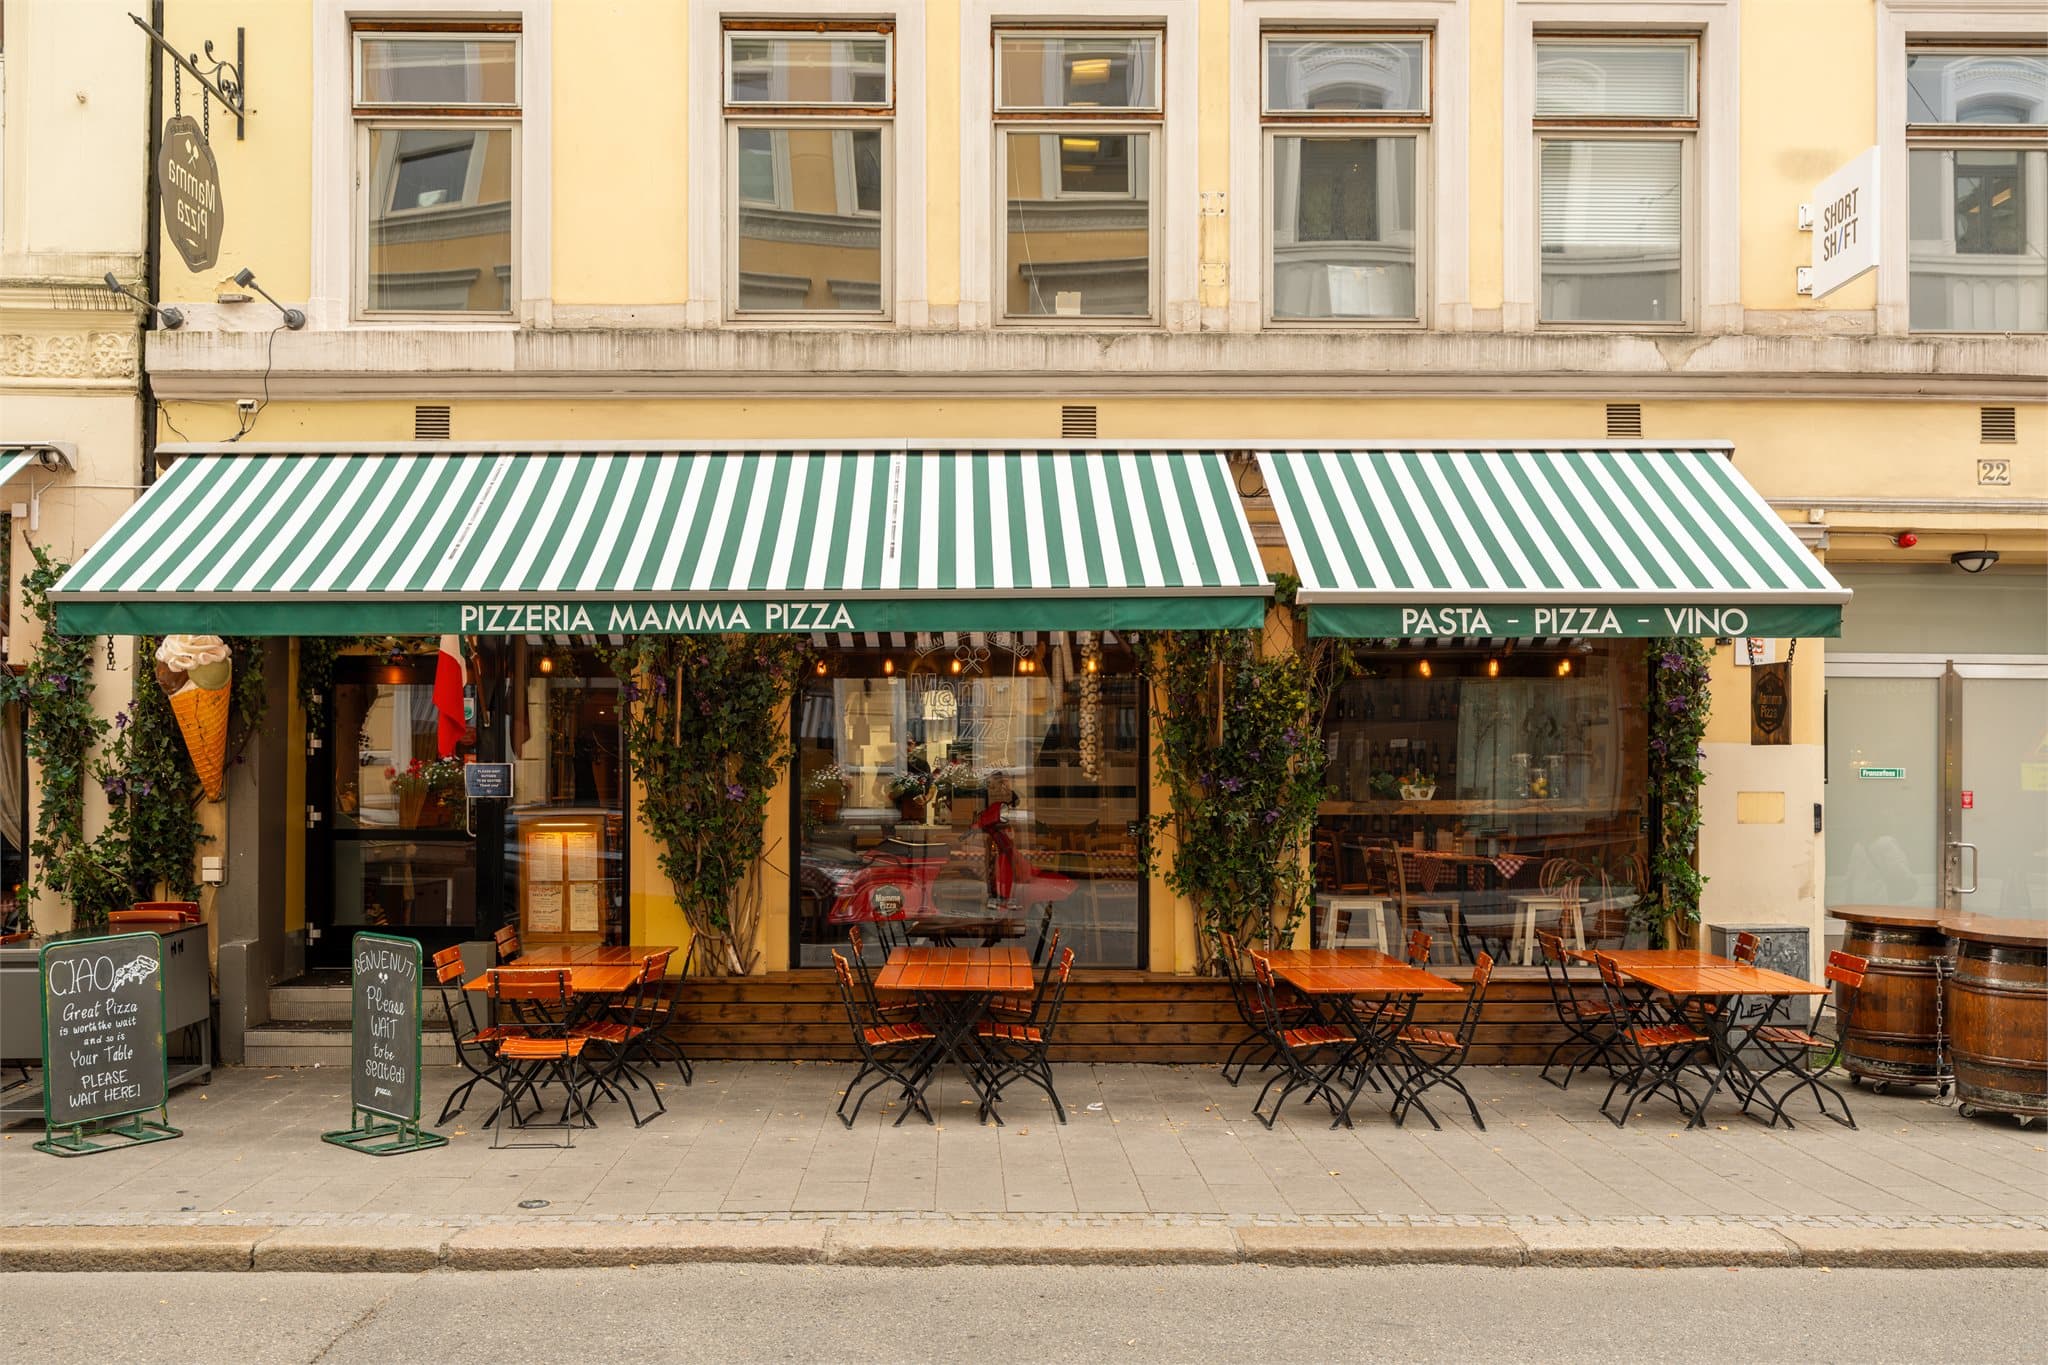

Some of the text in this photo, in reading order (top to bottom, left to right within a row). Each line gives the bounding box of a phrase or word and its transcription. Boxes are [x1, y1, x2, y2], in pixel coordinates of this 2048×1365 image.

[1823, 187, 1859, 233] SHORT
[1982, 462, 2009, 481] 22
[461, 602, 856, 632] PIZZERIA MAMMA PIZZA
[1402, 607, 1493, 635] PASTA
[1534, 607, 1623, 634] PIZZA
[1663, 607, 1749, 635] VINO
[50, 955, 115, 996] CIAO
[354, 950, 417, 982] BENVENUTI
[63, 998, 138, 1022] Great Pizza
[366, 985, 406, 1016] Please
[115, 1015, 137, 1029] wait
[83, 1034, 103, 1046] and
[116, 1031, 126, 1042] is
[70, 1044, 134, 1069] Your Table
[81, 1069, 129, 1089] PLEASE
[69, 1083, 141, 1108] WAIT HERE!
